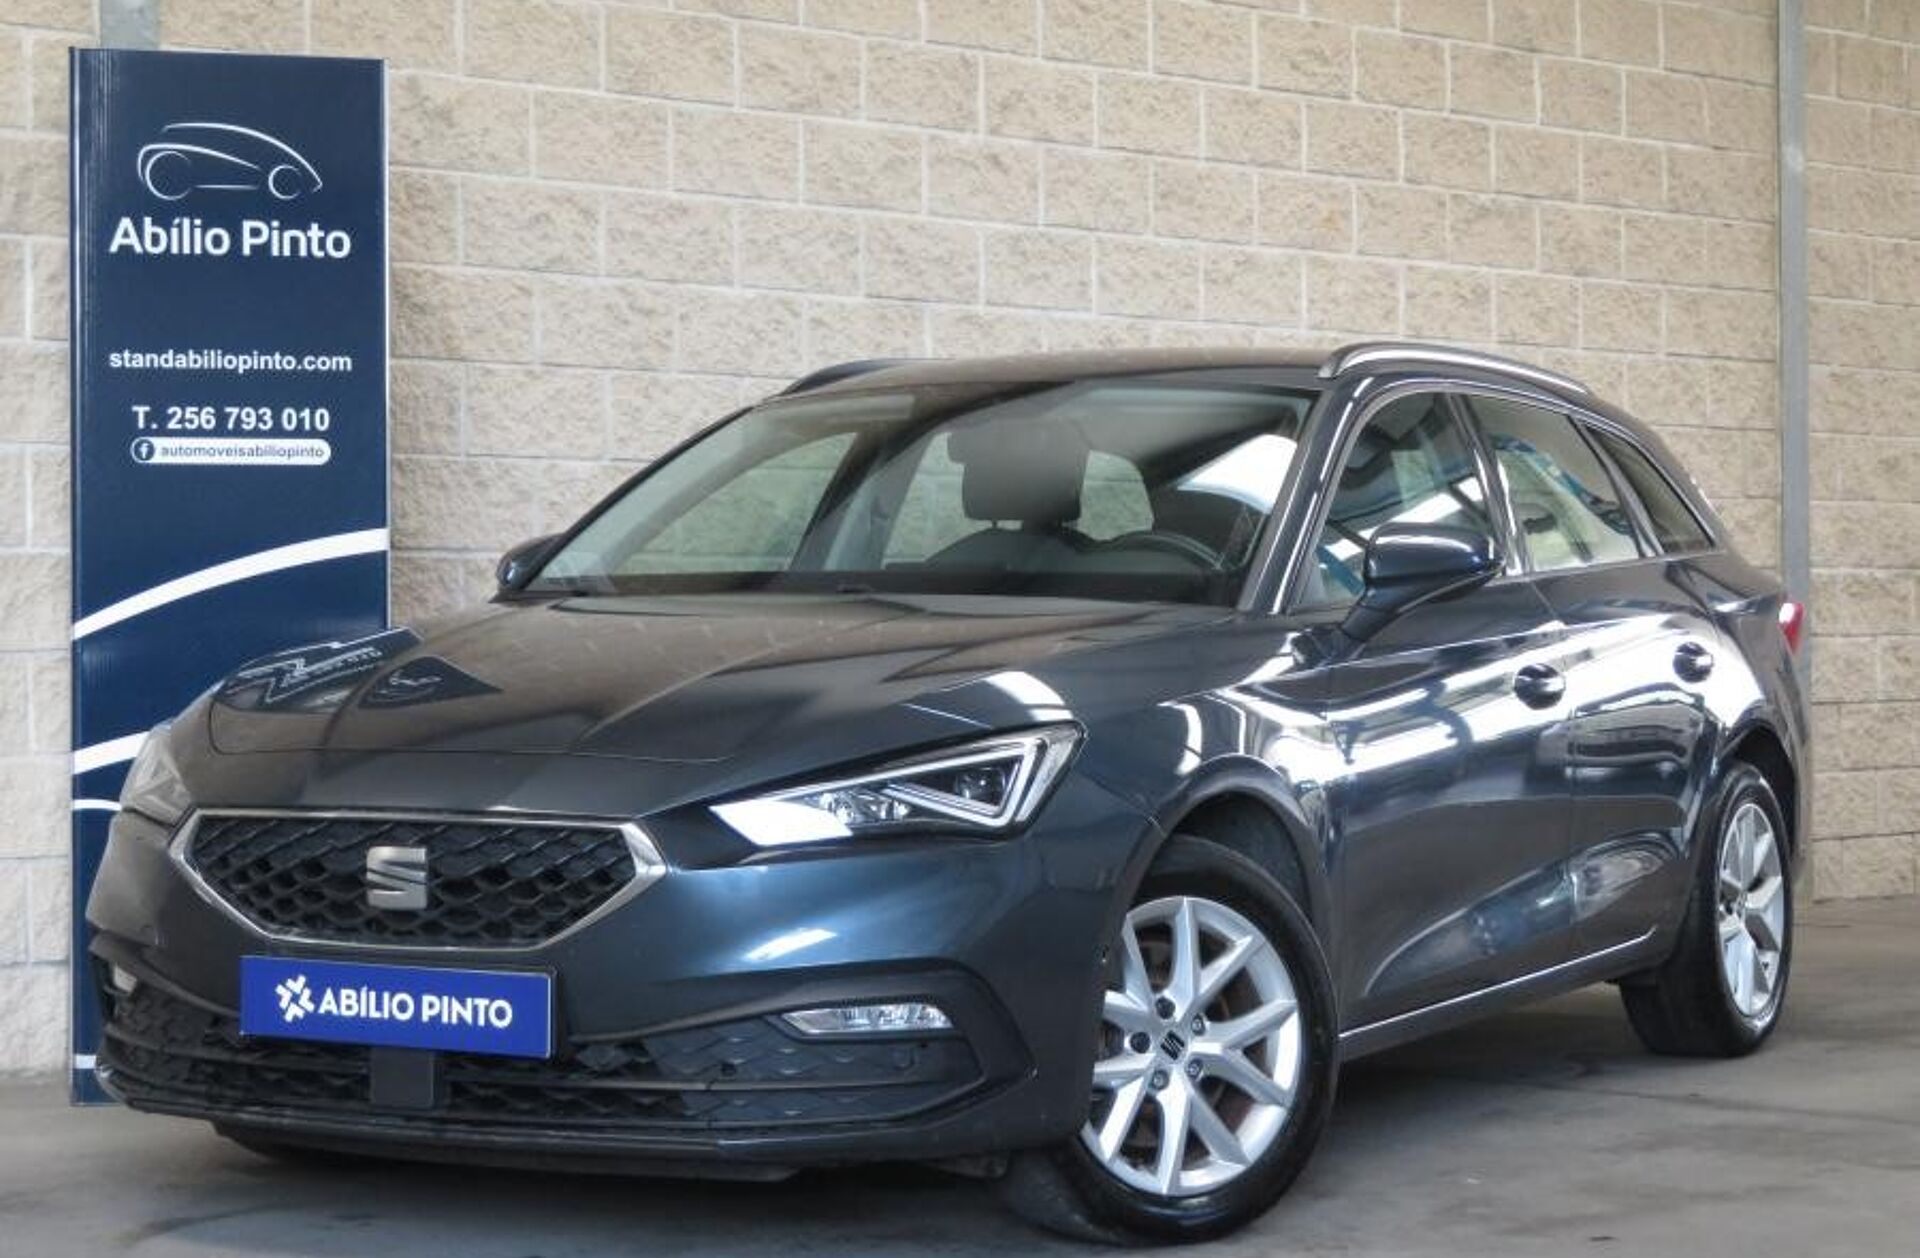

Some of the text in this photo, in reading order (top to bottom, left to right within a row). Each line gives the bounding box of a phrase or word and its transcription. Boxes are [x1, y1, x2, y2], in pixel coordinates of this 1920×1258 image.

[109, 217, 352, 258] Abílio Pinto
[109, 349, 353, 373] standabiliopinto.com
[131, 406, 330, 431] T. 256 793 010
[160, 441, 325, 460] automoveisabiliopinto
[317, 986, 513, 1028] ABÍLIO PINTO
